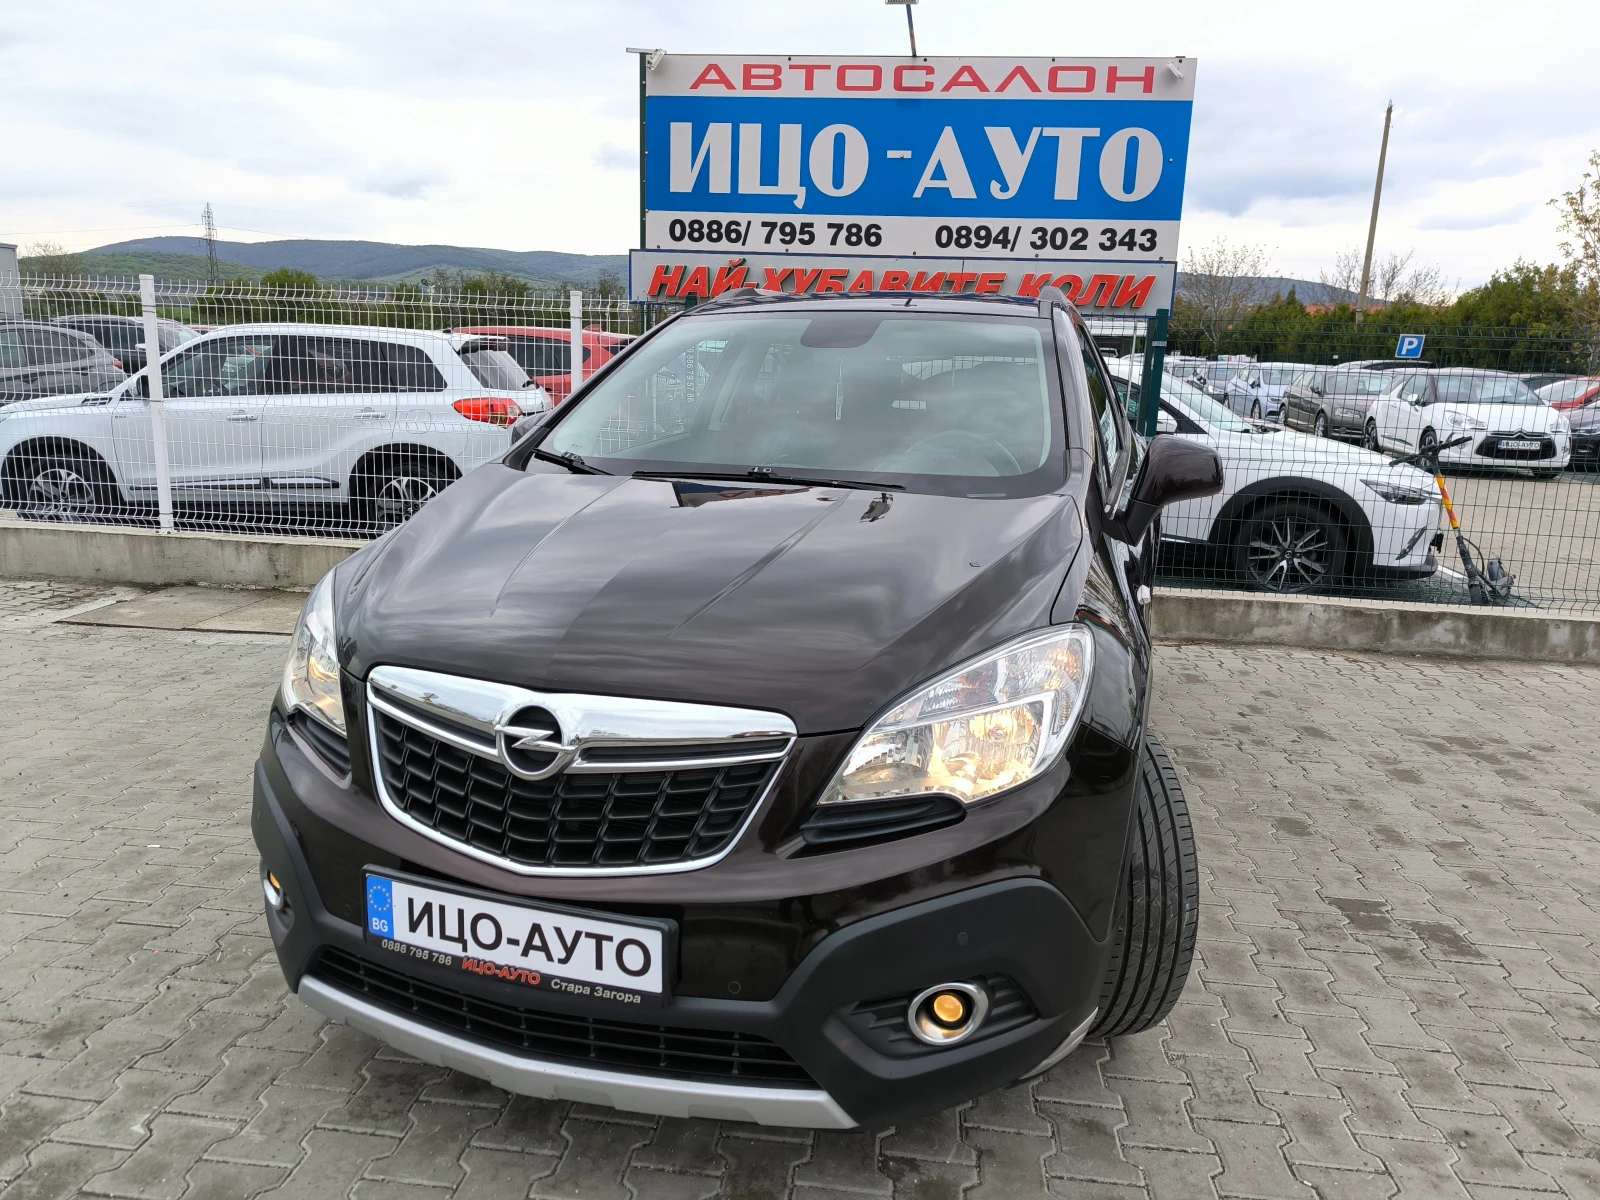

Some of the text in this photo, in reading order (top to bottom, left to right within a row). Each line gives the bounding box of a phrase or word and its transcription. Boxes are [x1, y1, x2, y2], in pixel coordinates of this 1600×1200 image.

[689, 63, 1155, 94] АВТОСАЛОН
[669, 219, 882, 247] 0886/ 795 786
[935, 225, 1158, 252] 0894/ 302 343
[1017, 273, 1157, 308] КОЛИ
[1401, 337, 1418, 355] P
[372, 917, 389, 933] BG
[407, 897, 652, 977] ИЦО-АУТО
[381, 939, 642, 1004] 0886 795 786 ИЦО-АУТО Стара Загора
